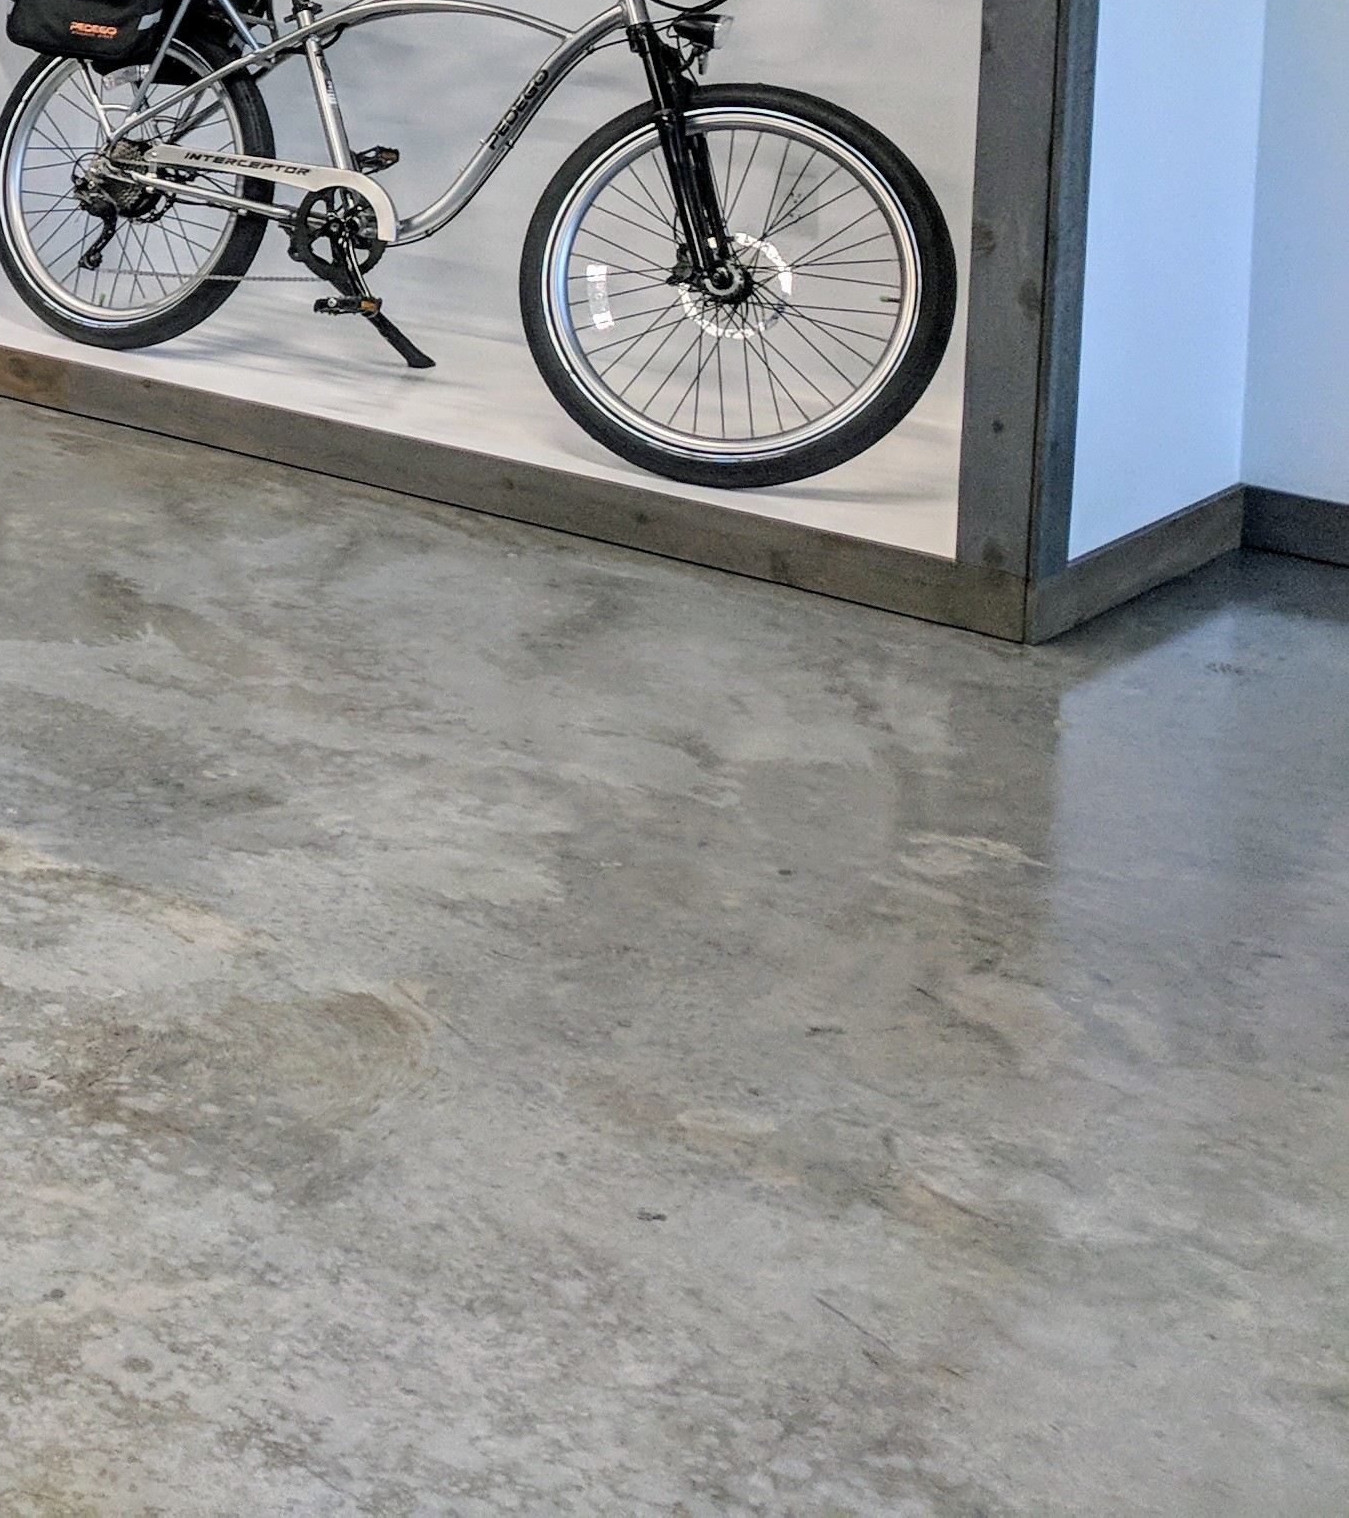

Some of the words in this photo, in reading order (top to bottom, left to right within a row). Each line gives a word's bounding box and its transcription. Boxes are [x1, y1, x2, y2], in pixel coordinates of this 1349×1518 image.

[69, 21, 118, 35] PEDEGO
[487, 69, 550, 151] PEDEGO
[184, 151, 312, 178] INTERCEPTOR
